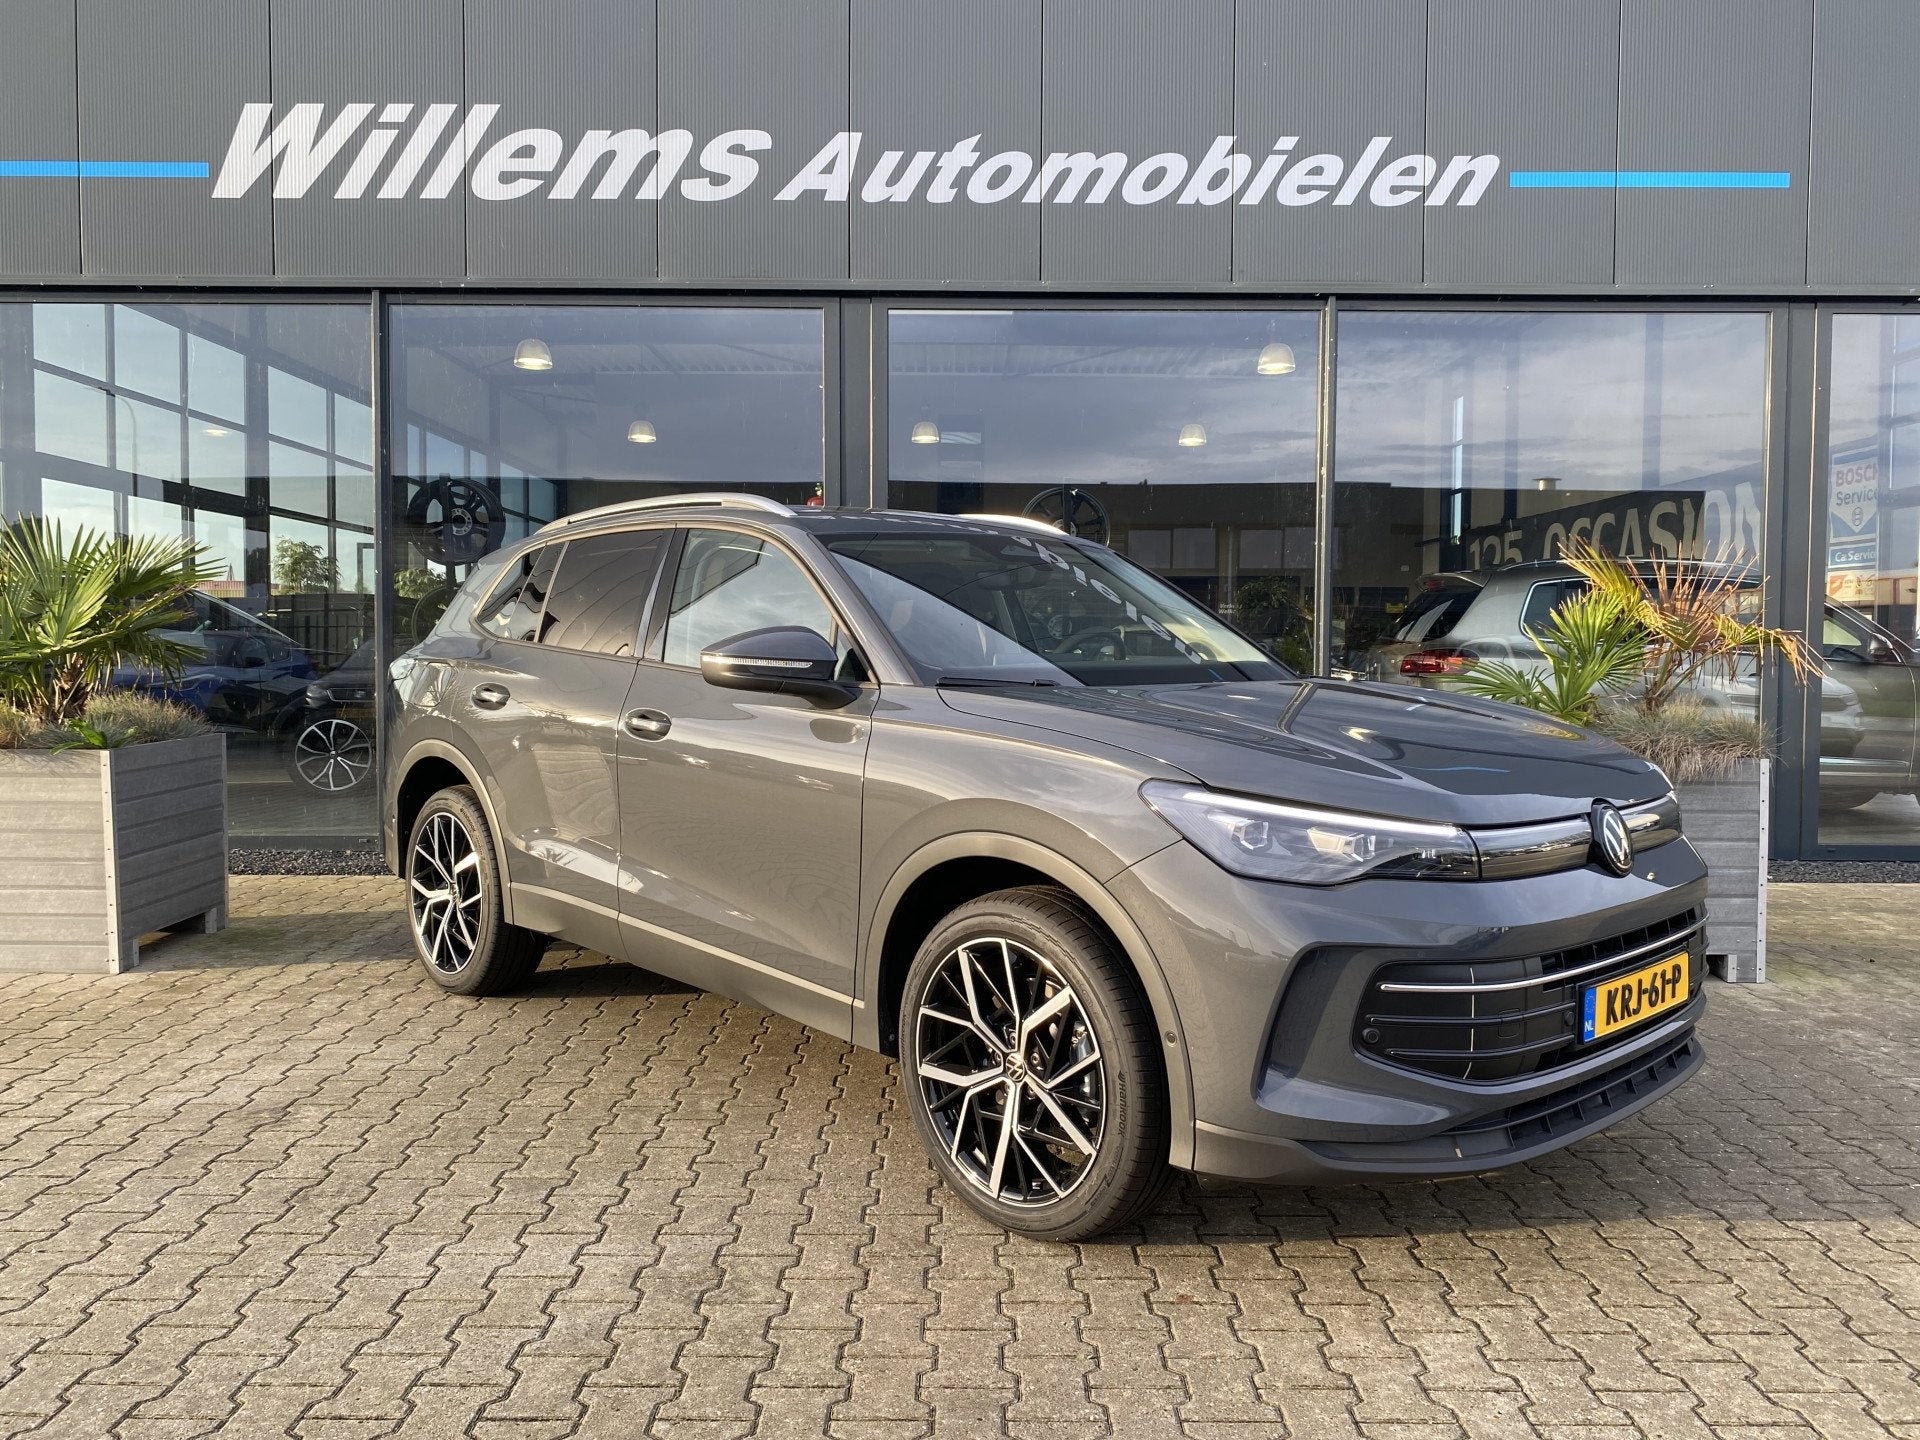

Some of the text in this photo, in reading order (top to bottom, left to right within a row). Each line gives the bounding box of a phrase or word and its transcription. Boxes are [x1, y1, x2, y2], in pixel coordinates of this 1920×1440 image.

[211, 102, 1500, 207] Willems Automobielen
[1605, 964, 1682, 1026] KRJ-61-P
[1584, 1020, 1594, 1033] NL
